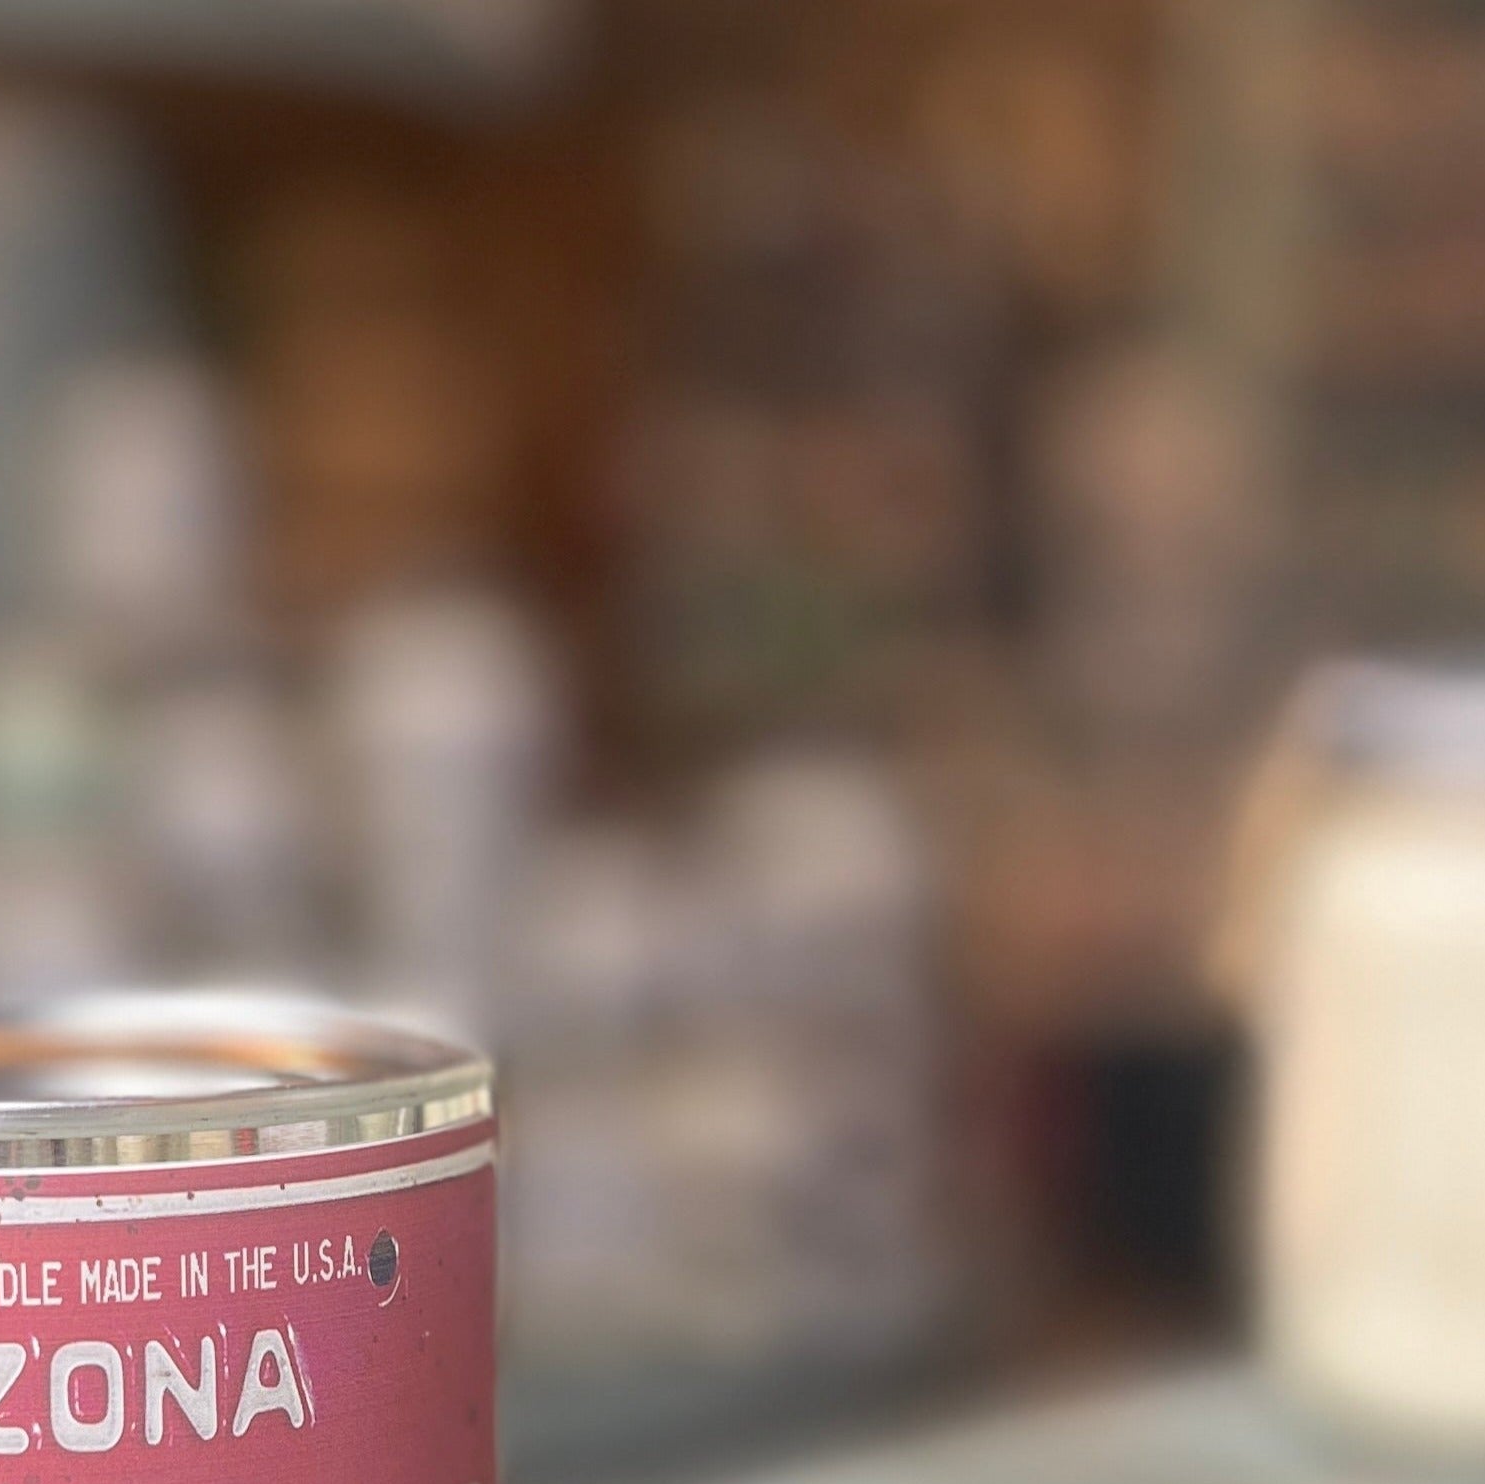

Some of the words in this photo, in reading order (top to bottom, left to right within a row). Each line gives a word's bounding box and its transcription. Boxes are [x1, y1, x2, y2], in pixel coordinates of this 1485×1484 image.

[80, 1256, 162, 1303] MADE
[180, 1252, 209, 1297] IN
[225, 1246, 278, 1293] THE
[293, 1235, 363, 1284] U.S.A.
